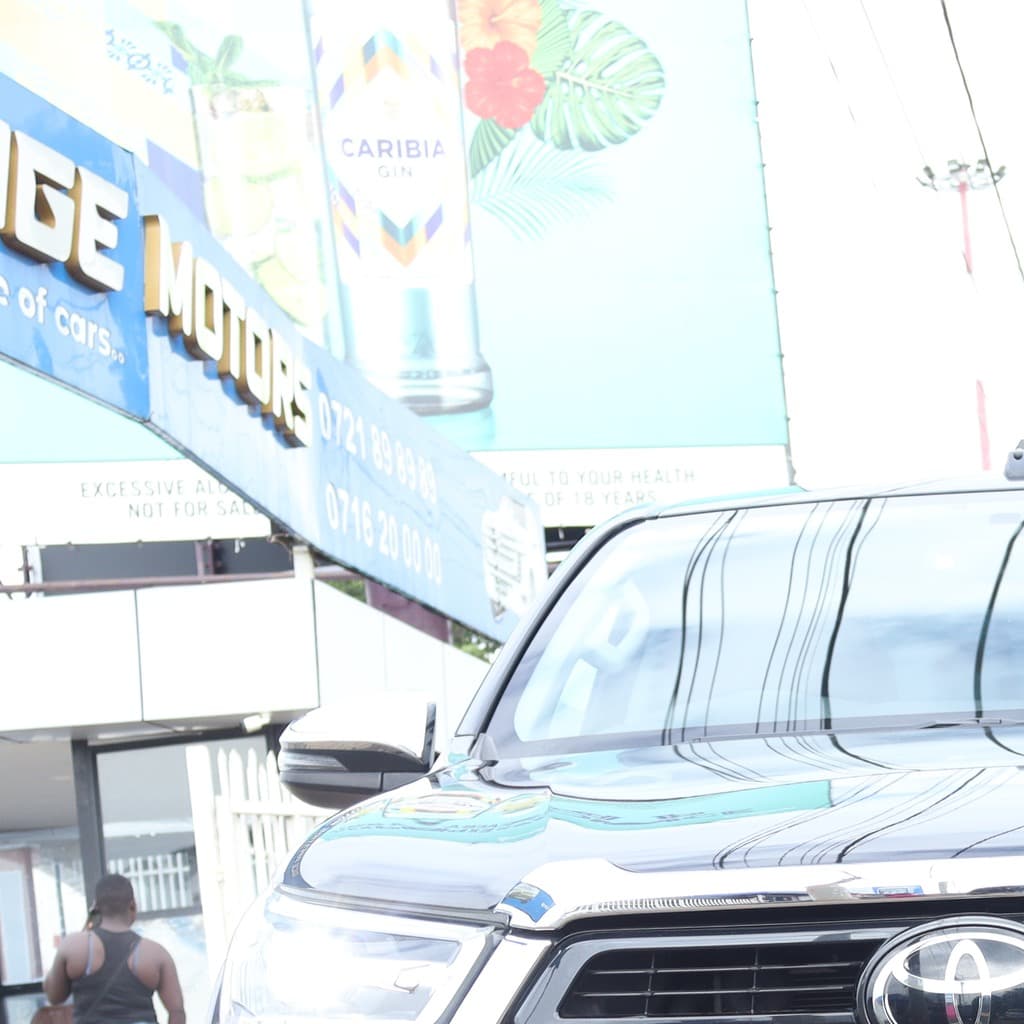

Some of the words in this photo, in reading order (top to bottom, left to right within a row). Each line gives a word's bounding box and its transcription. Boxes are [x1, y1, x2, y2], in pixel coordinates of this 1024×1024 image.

[342, 138, 446, 159] CARIBIA
[378, 164, 412, 178] GIN
[18, 286, 48, 325] of
[143, 214, 312, 448] MOTORS
[318, 392, 366, 461] 0721
[370, 423, 393, 477] 89
[395, 439, 417, 492] 89
[549, 470, 569, 486] TO
[576, 469, 623, 486] YOUR
[631, 468, 696, 485] HEALTH
[80, 479, 184, 498] EXCESSIVE
[544, 490, 563, 507] OF
[573, 490, 595, 506] 18
[599, 489, 657, 507] YEARS
[127, 502, 165, 519] NOT
[173, 501, 208, 517] FOR
[325, 483, 373, 548] 0716
[378, 510, 400, 561] 20
[402, 523, 423, 575] 00
